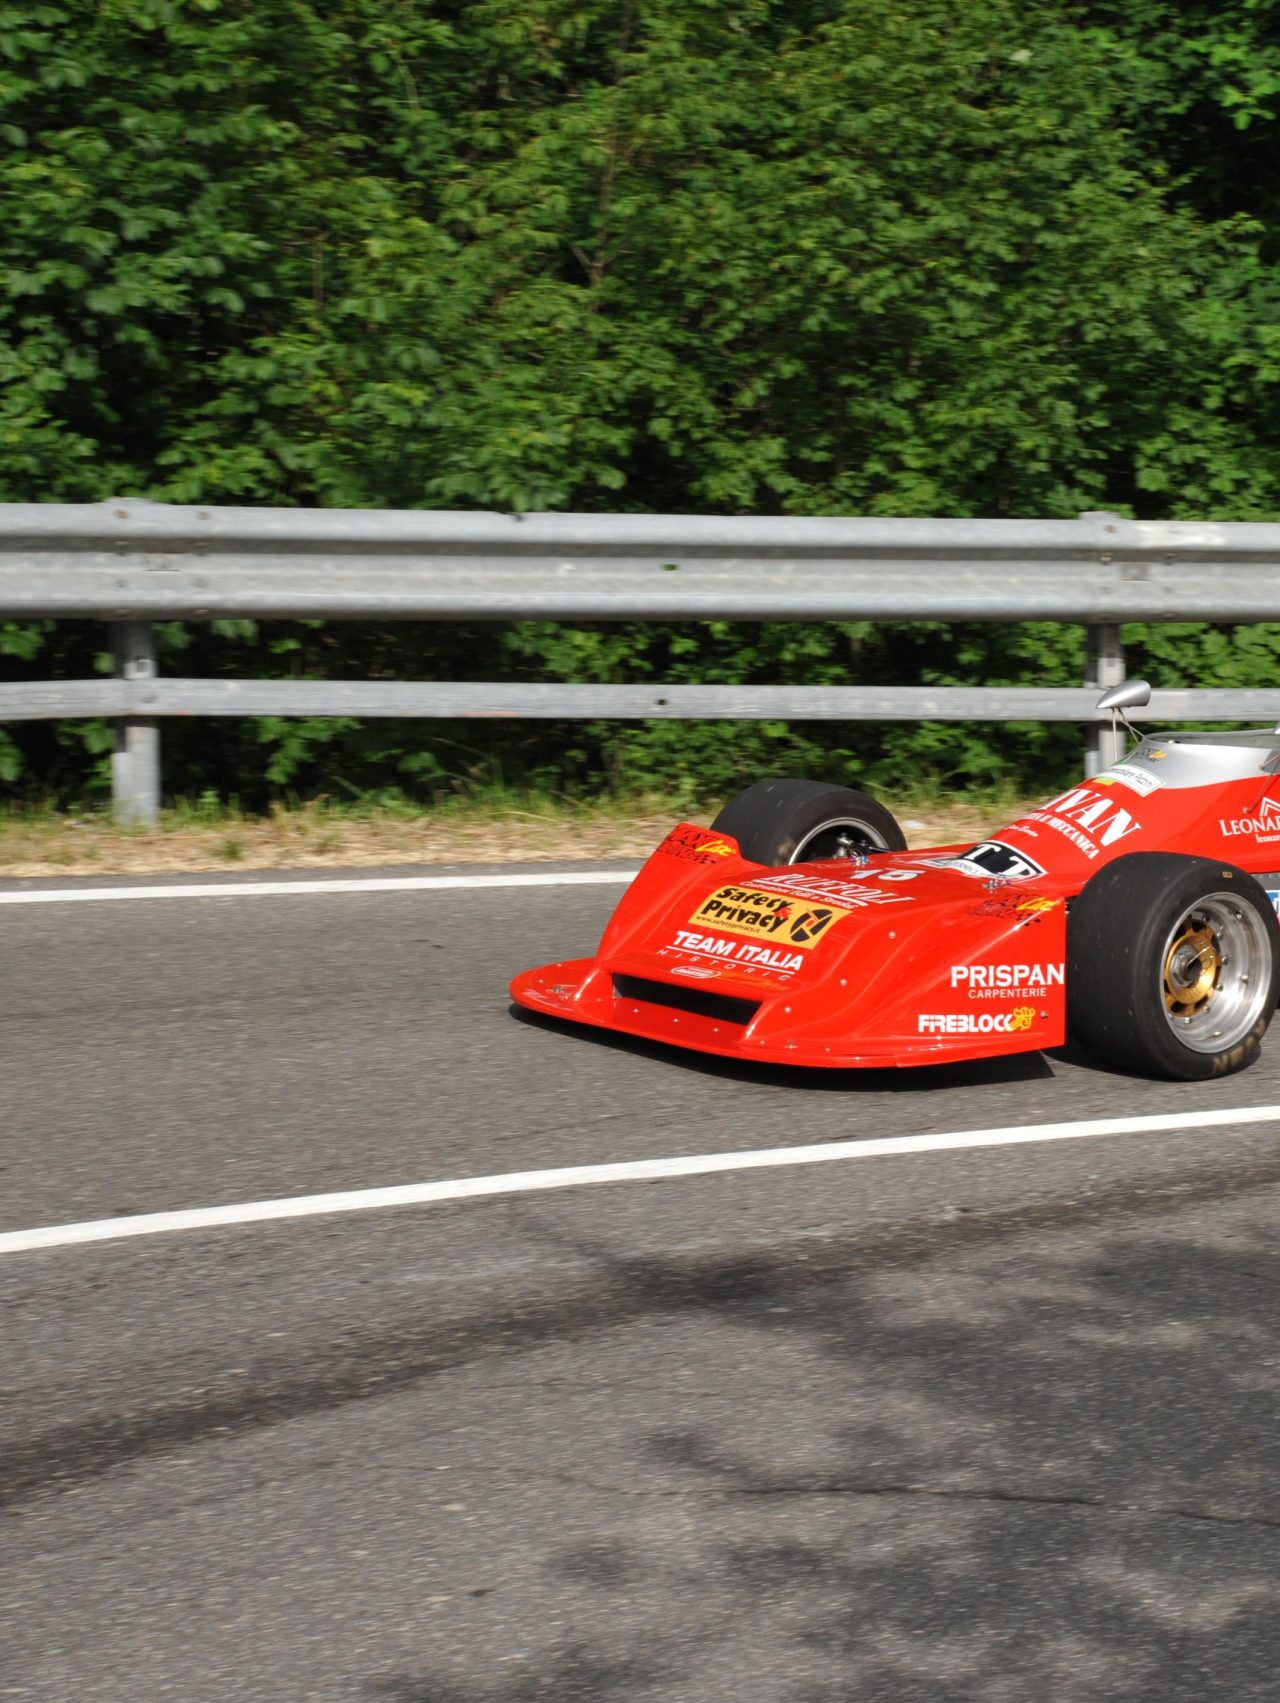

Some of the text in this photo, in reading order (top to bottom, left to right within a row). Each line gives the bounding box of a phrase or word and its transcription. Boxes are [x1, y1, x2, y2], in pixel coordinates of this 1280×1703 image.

[1048, 816, 1100, 860] MECCANICA
[849, 868, 926, 881] 15
[716, 888, 795, 912] Safety
[701, 899, 789, 933] Privacy
[656, 949, 791, 982] HISTORIC
[673, 931, 804, 971] TEAM ITALIA
[951, 963, 1065, 988] PRISPAN
[968, 987, 1047, 999] CARPENTERIE
